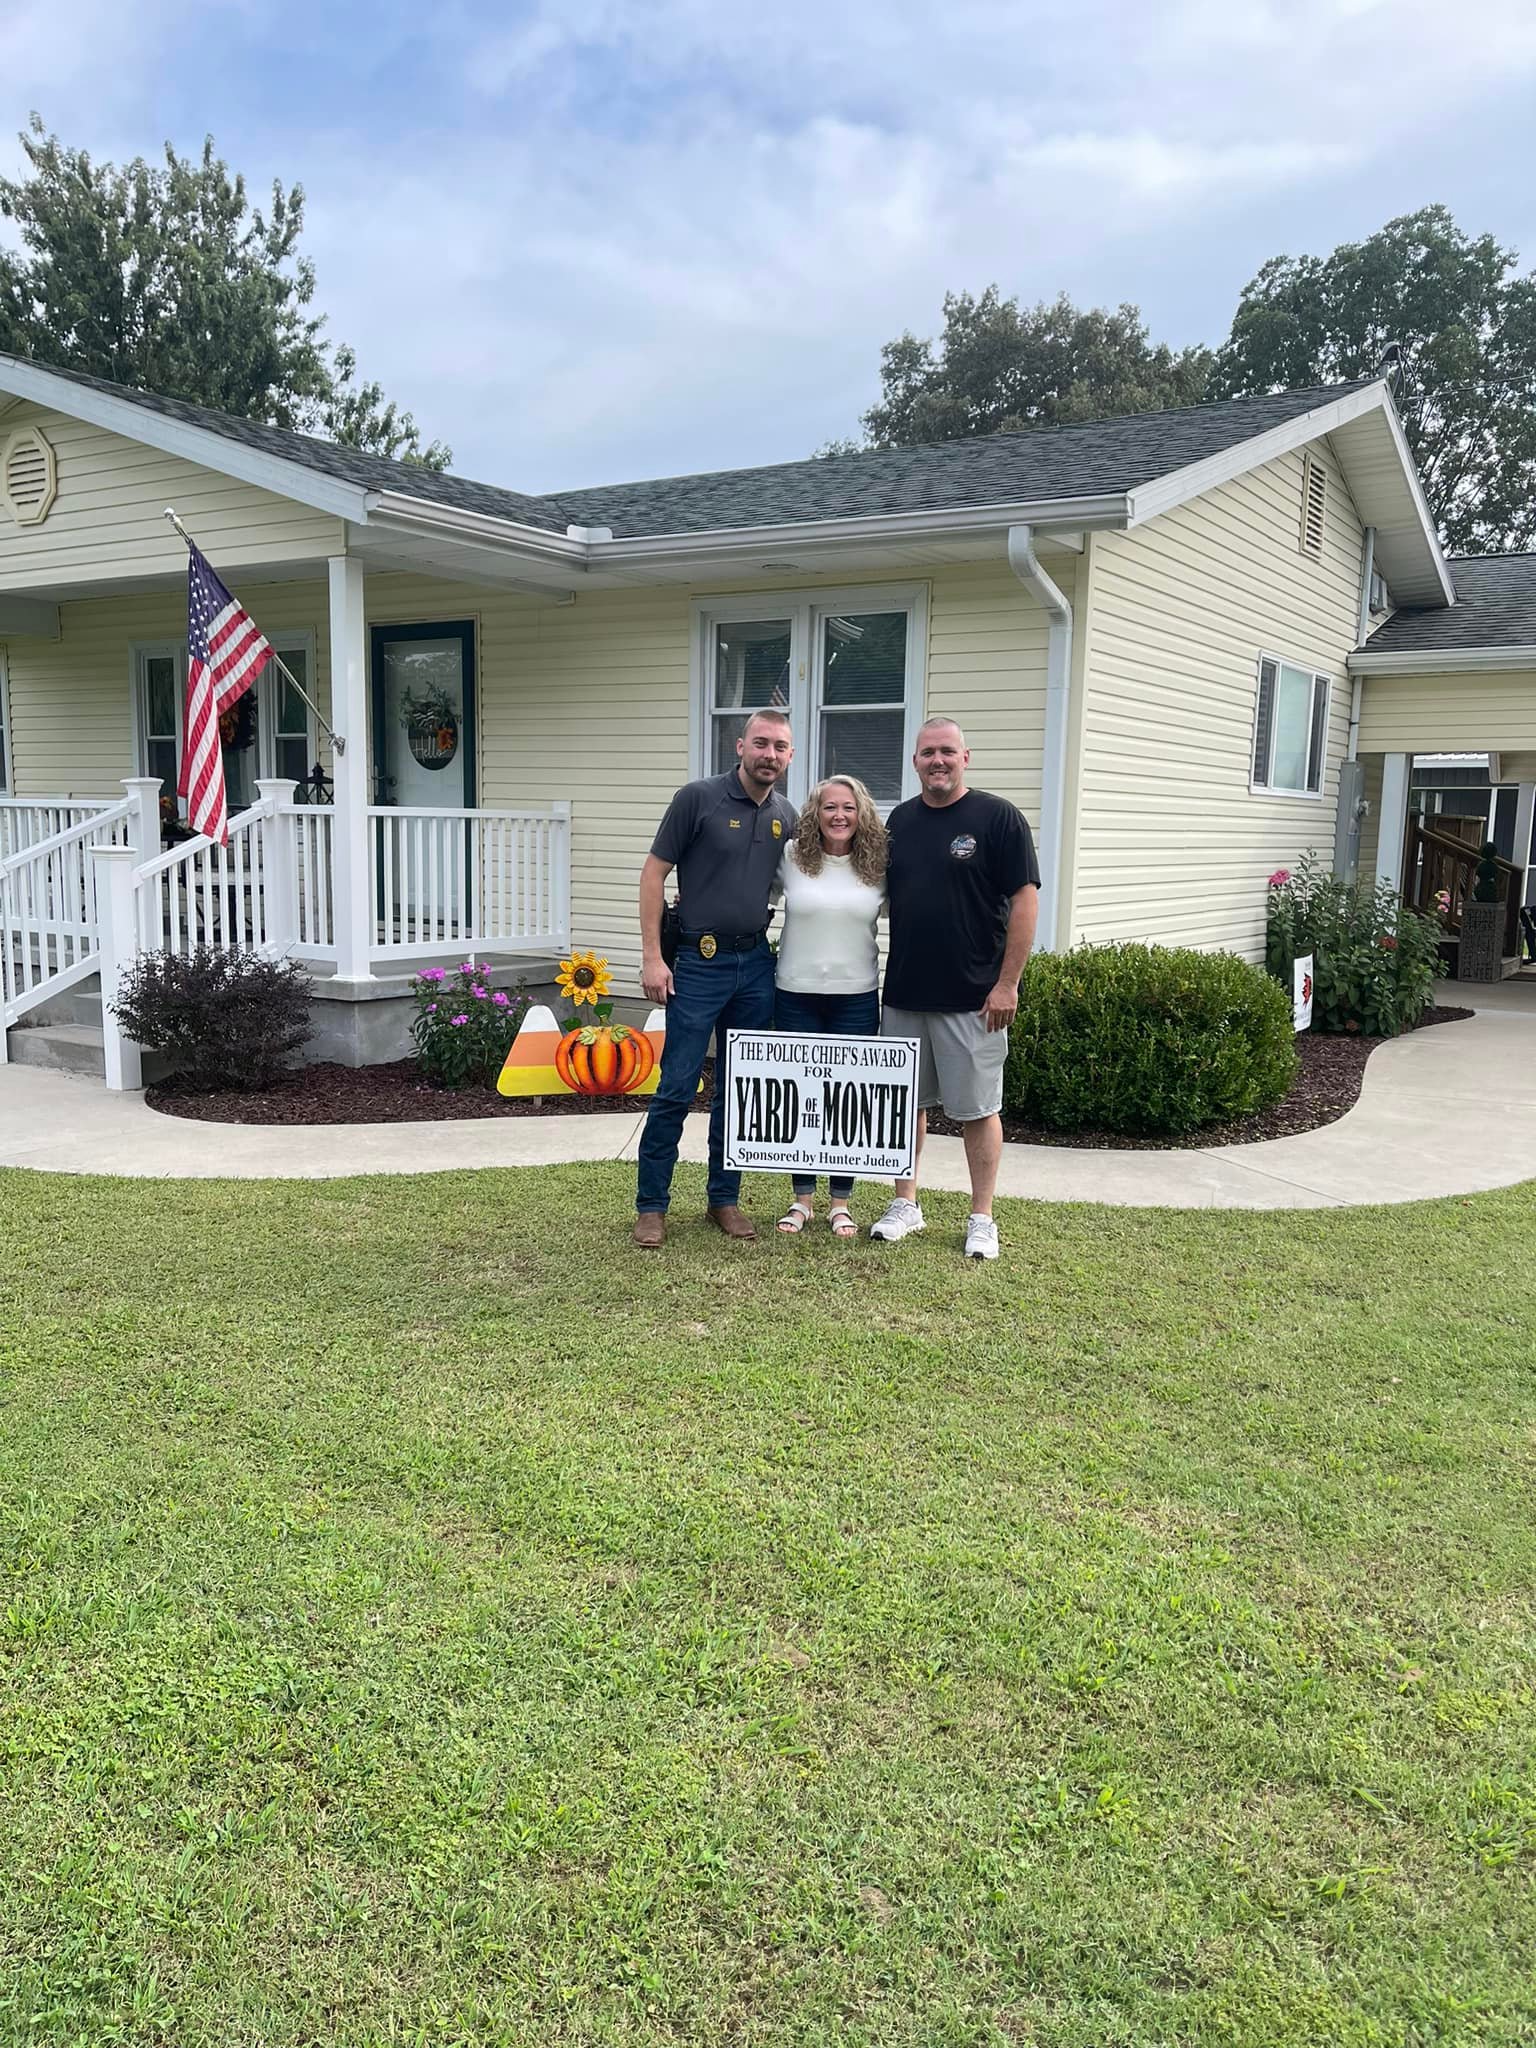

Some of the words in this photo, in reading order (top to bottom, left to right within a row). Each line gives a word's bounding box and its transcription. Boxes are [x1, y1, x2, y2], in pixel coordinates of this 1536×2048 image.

[739, 1041, 764, 1061] THE
[766, 1043, 809, 1063] POLICE
[811, 1045, 858, 1066] CHIEF'S
[860, 1048, 907, 1068] AWARD
[804, 1066, 832, 1079] FOR
[735, 1076, 800, 1144] YARD
[805, 1098, 818, 1112] OF
[821, 1080, 909, 1150] MONTH
[801, 1113, 820, 1128] THE
[738, 1147, 800, 1163] Sponsored
[802, 1150, 816, 1166] by
[819, 1151, 861, 1166] Hunter
[863, 1153, 900, 1168] Juden
